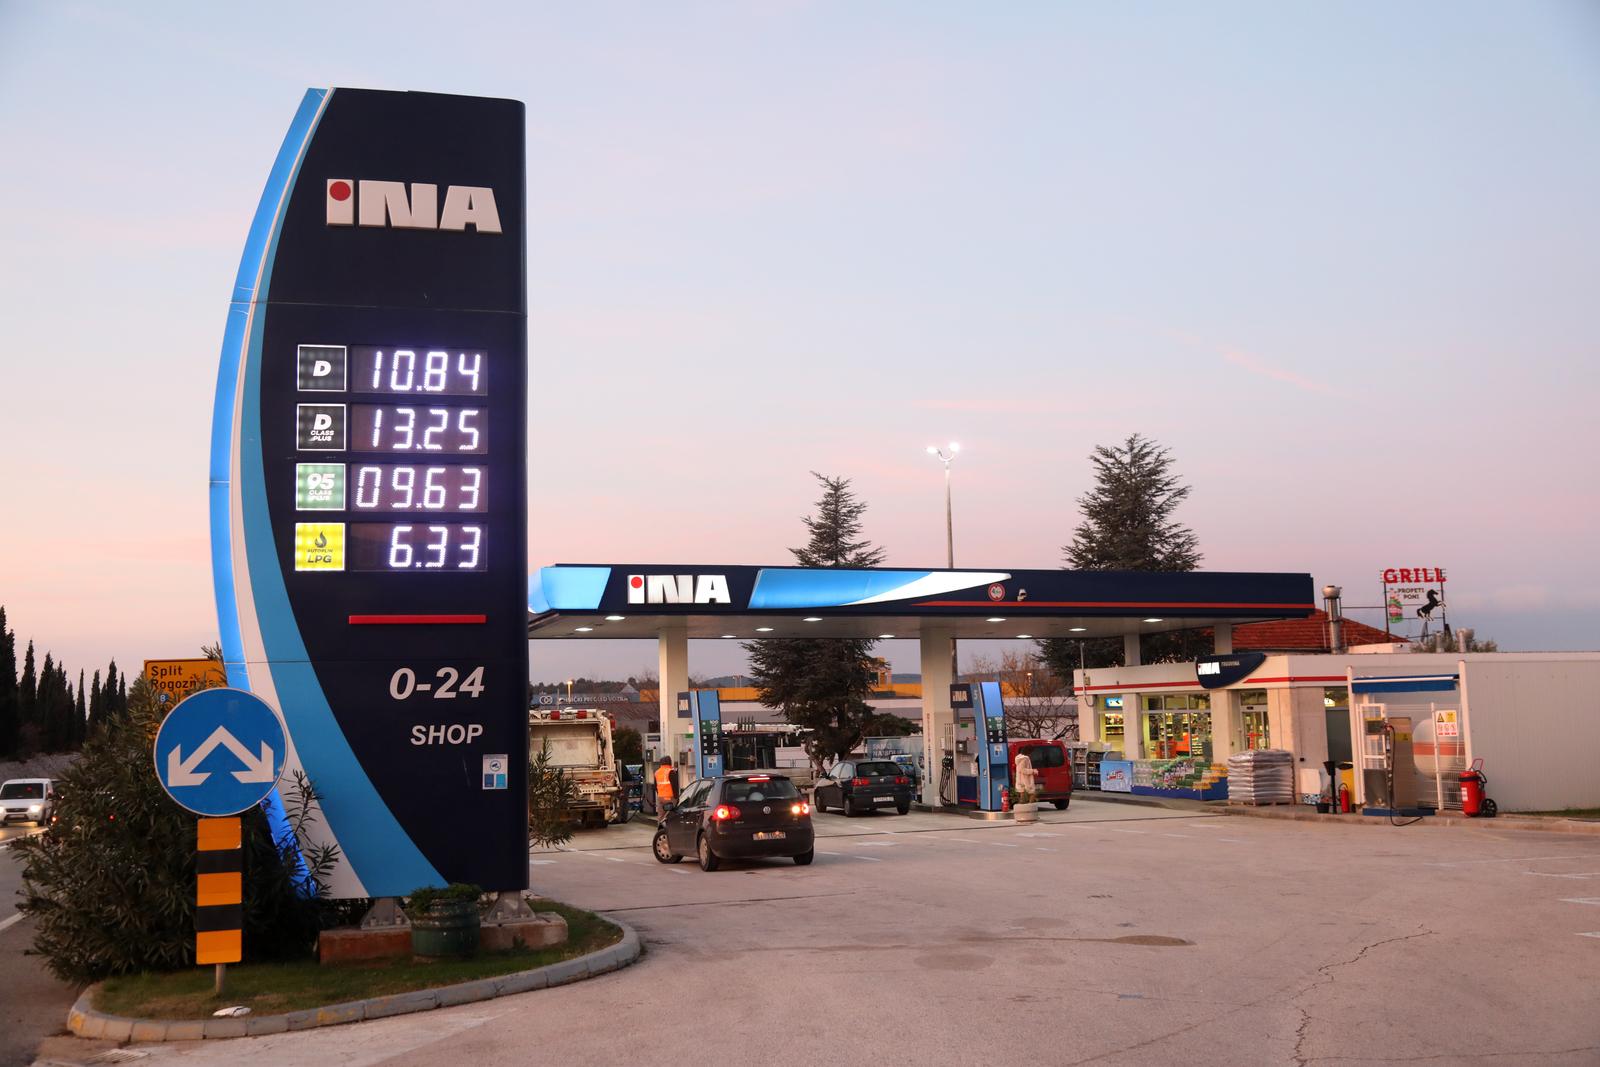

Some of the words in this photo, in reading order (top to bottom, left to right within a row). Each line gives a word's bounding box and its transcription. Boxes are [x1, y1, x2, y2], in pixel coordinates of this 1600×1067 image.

[313, 360, 331, 376] D
[372, 350, 481, 391] 10.84
[313, 413, 332, 430] D
[372, 408, 480, 450] 13.25
[307, 473, 335, 490] 95
[356, 466, 481, 509] 09.63
[388, 525, 481, 568] 6.33
[307, 555, 332, 563] LPG
[1383, 567, 1446, 584] GRILL
[151, 665, 183, 679] Split
[389, 666, 485, 700] 0-24
[410, 724, 484, 746] SHOP
